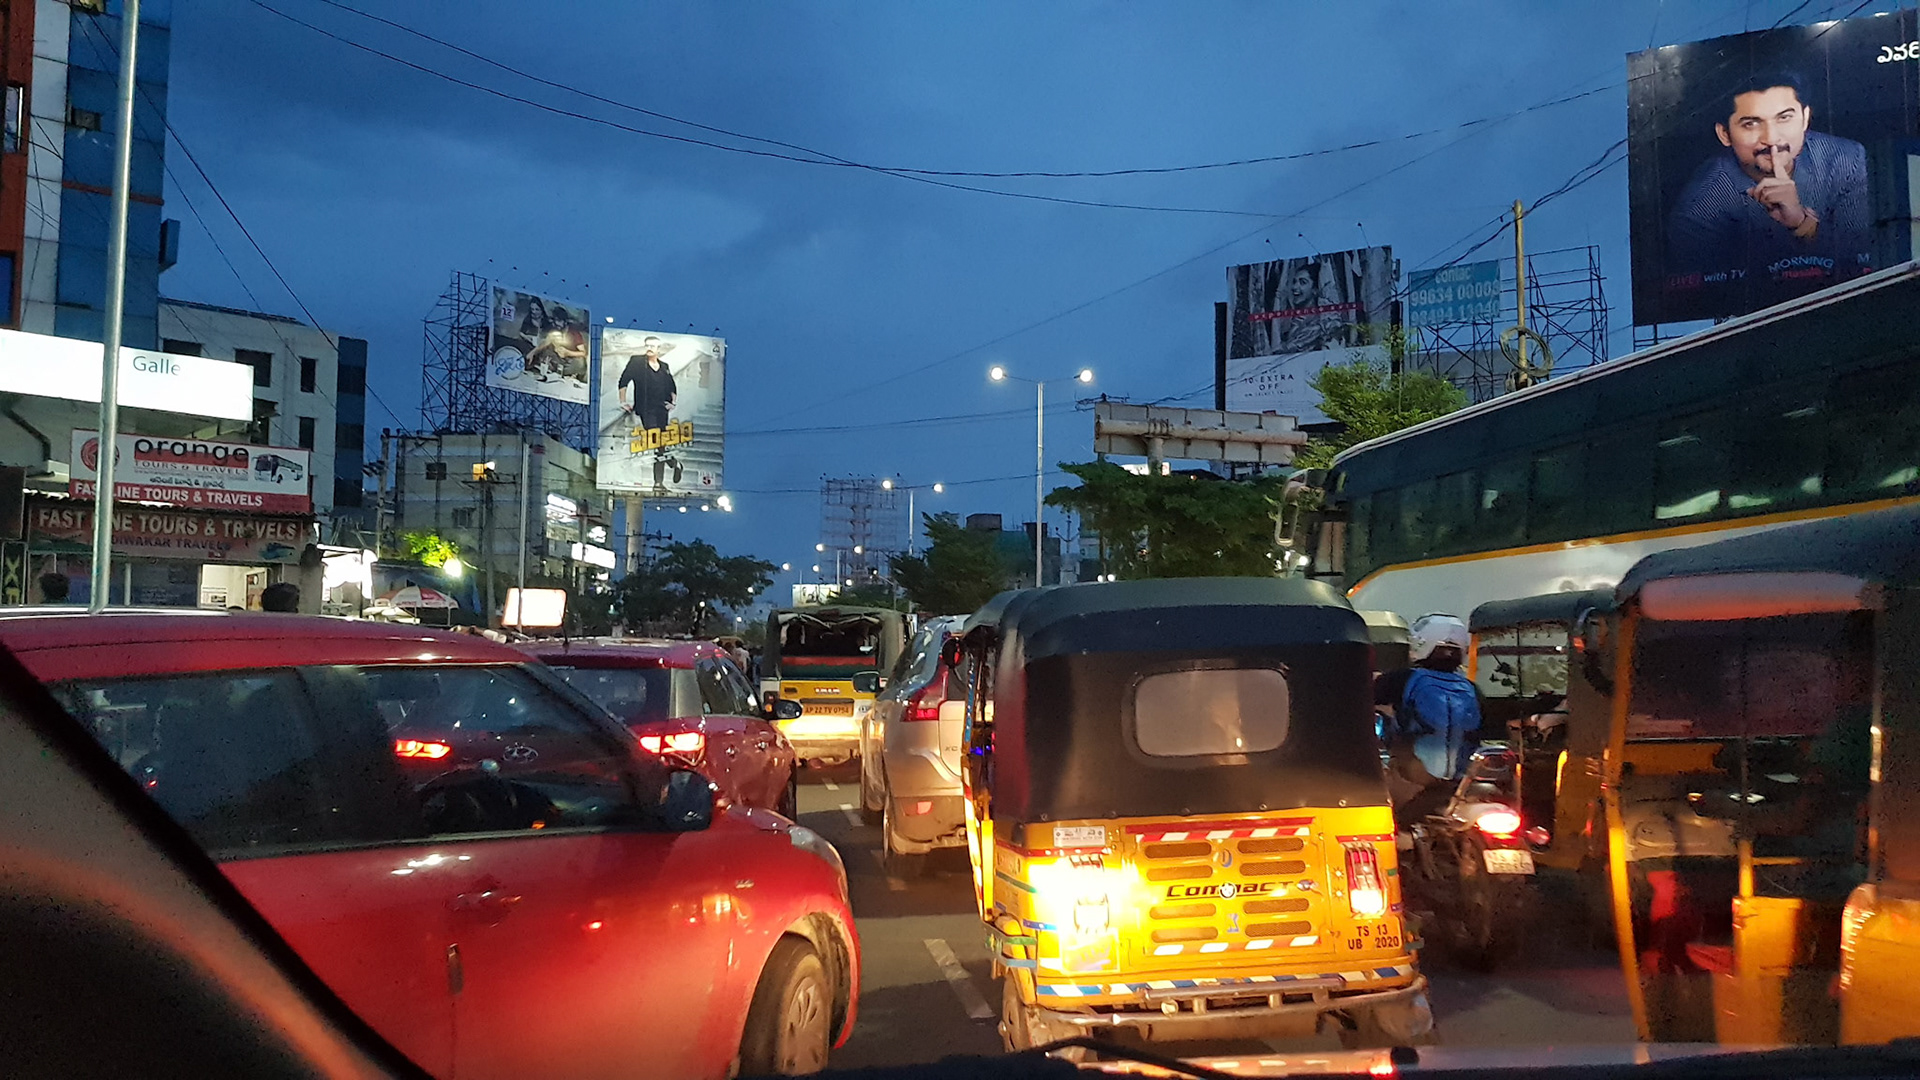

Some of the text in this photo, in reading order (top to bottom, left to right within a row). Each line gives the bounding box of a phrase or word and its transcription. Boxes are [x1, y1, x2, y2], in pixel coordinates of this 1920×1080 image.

[1767, 255, 1834, 274] MORNING
[1703, 272, 1728, 283] with
[1260, 374, 1295, 384] EXTRA
[1258, 383, 1280, 391] OFF
[134, 438, 249, 465] orange
[144, 488, 189, 502] TOURS
[193, 491, 202, 503] &
[206, 492, 263, 507] TRAVELS
[38, 508, 85, 529] FAST
[139, 515, 199, 536] TOURS
[204, 519, 216, 536] &
[1356, 923, 1388, 937] TS 13
[1347, 935, 1400, 950] UB 2020
